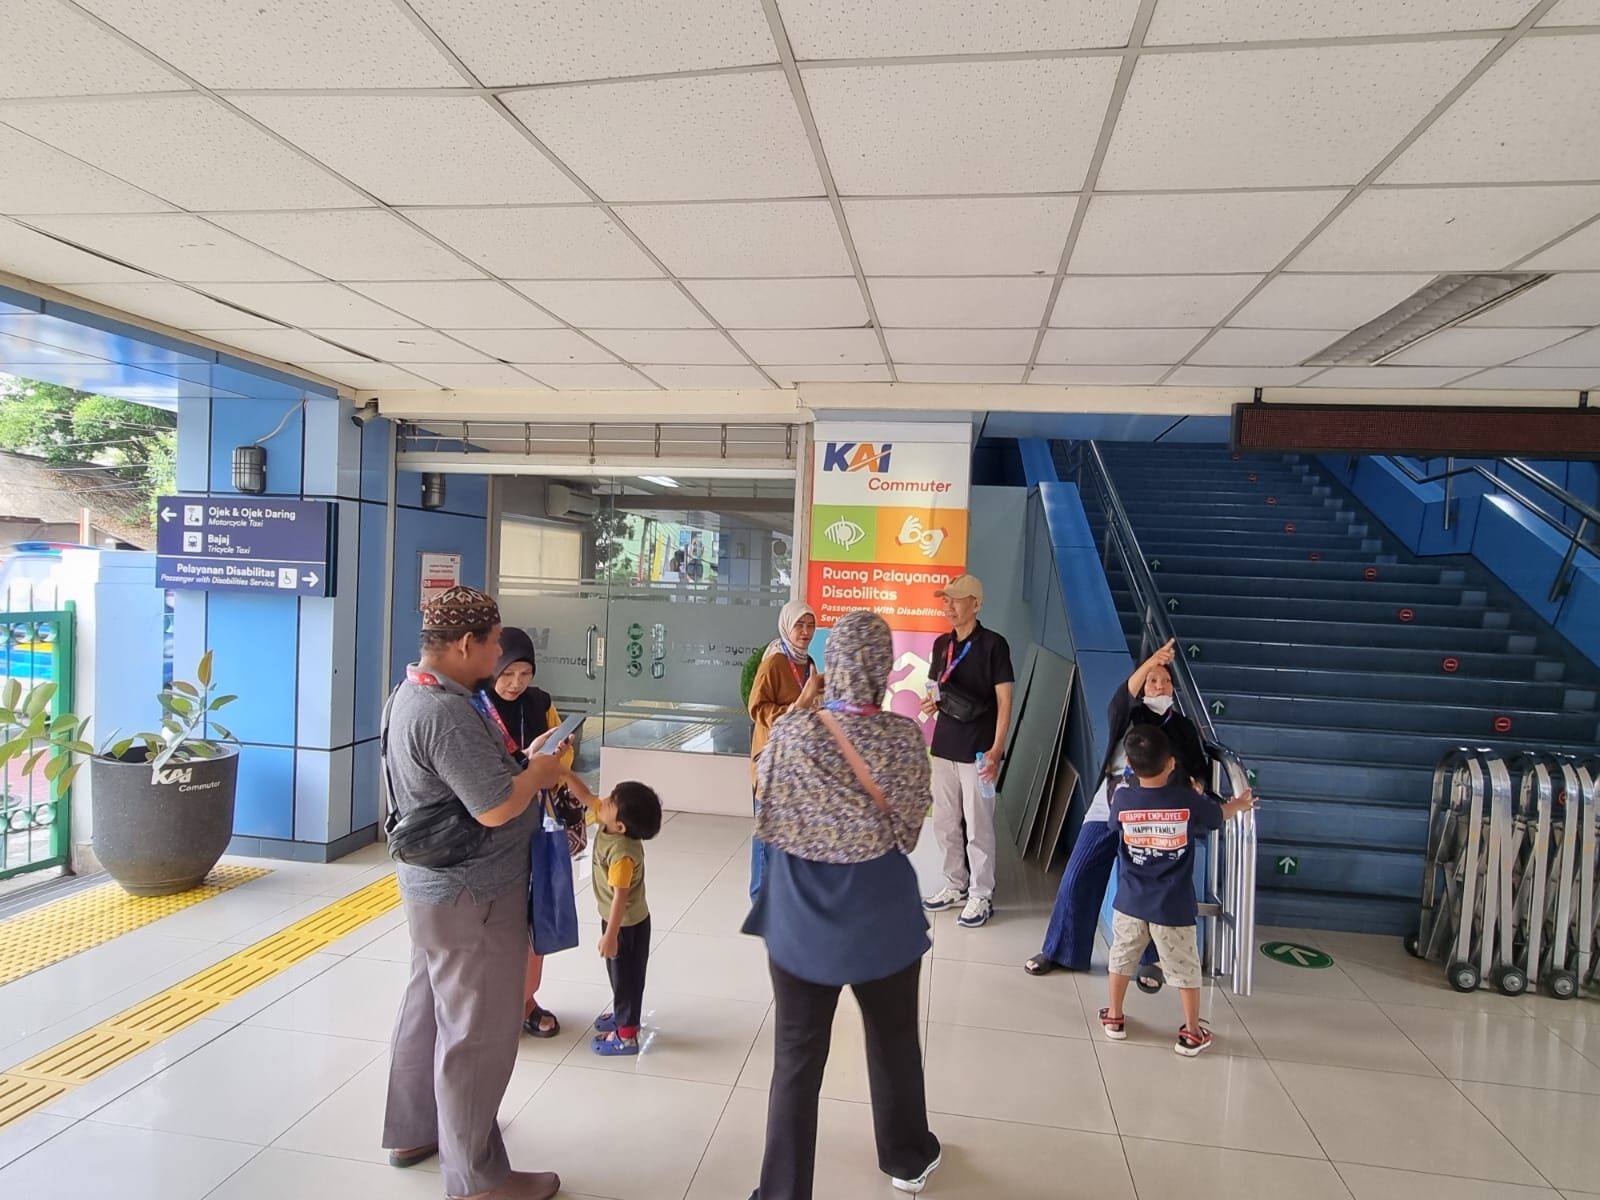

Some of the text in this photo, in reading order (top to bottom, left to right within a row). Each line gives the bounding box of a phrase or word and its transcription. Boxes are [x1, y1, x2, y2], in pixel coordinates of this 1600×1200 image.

[823, 443, 893, 473] KAI
[868, 477, 952, 492] Commuter
[208, 506, 296, 521] Ojek & Ojek Daring
[208, 519, 248, 527] Motorcycle
[207, 534, 230, 545] Bajaj
[207, 545, 251, 554] Tricycle Taxi
[177, 563, 276, 578] Pelayanan Disabilitas
[823, 567, 950, 586] Ruang Pelayanan
[161, 574, 275, 587] Passenger with Disabilities Service
[822, 585, 898, 601] Disabilitas
[873, 606, 895, 615] With
[896, 607, 946, 617] Disabilities
[820, 614, 843, 624] Serv
[151, 767, 193, 785] KAI
[178, 781, 221, 792] Commuter
[1125, 812, 1183, 820] HAPPY EMPLOYEE
[1155, 826, 1176, 834] FAMILY
